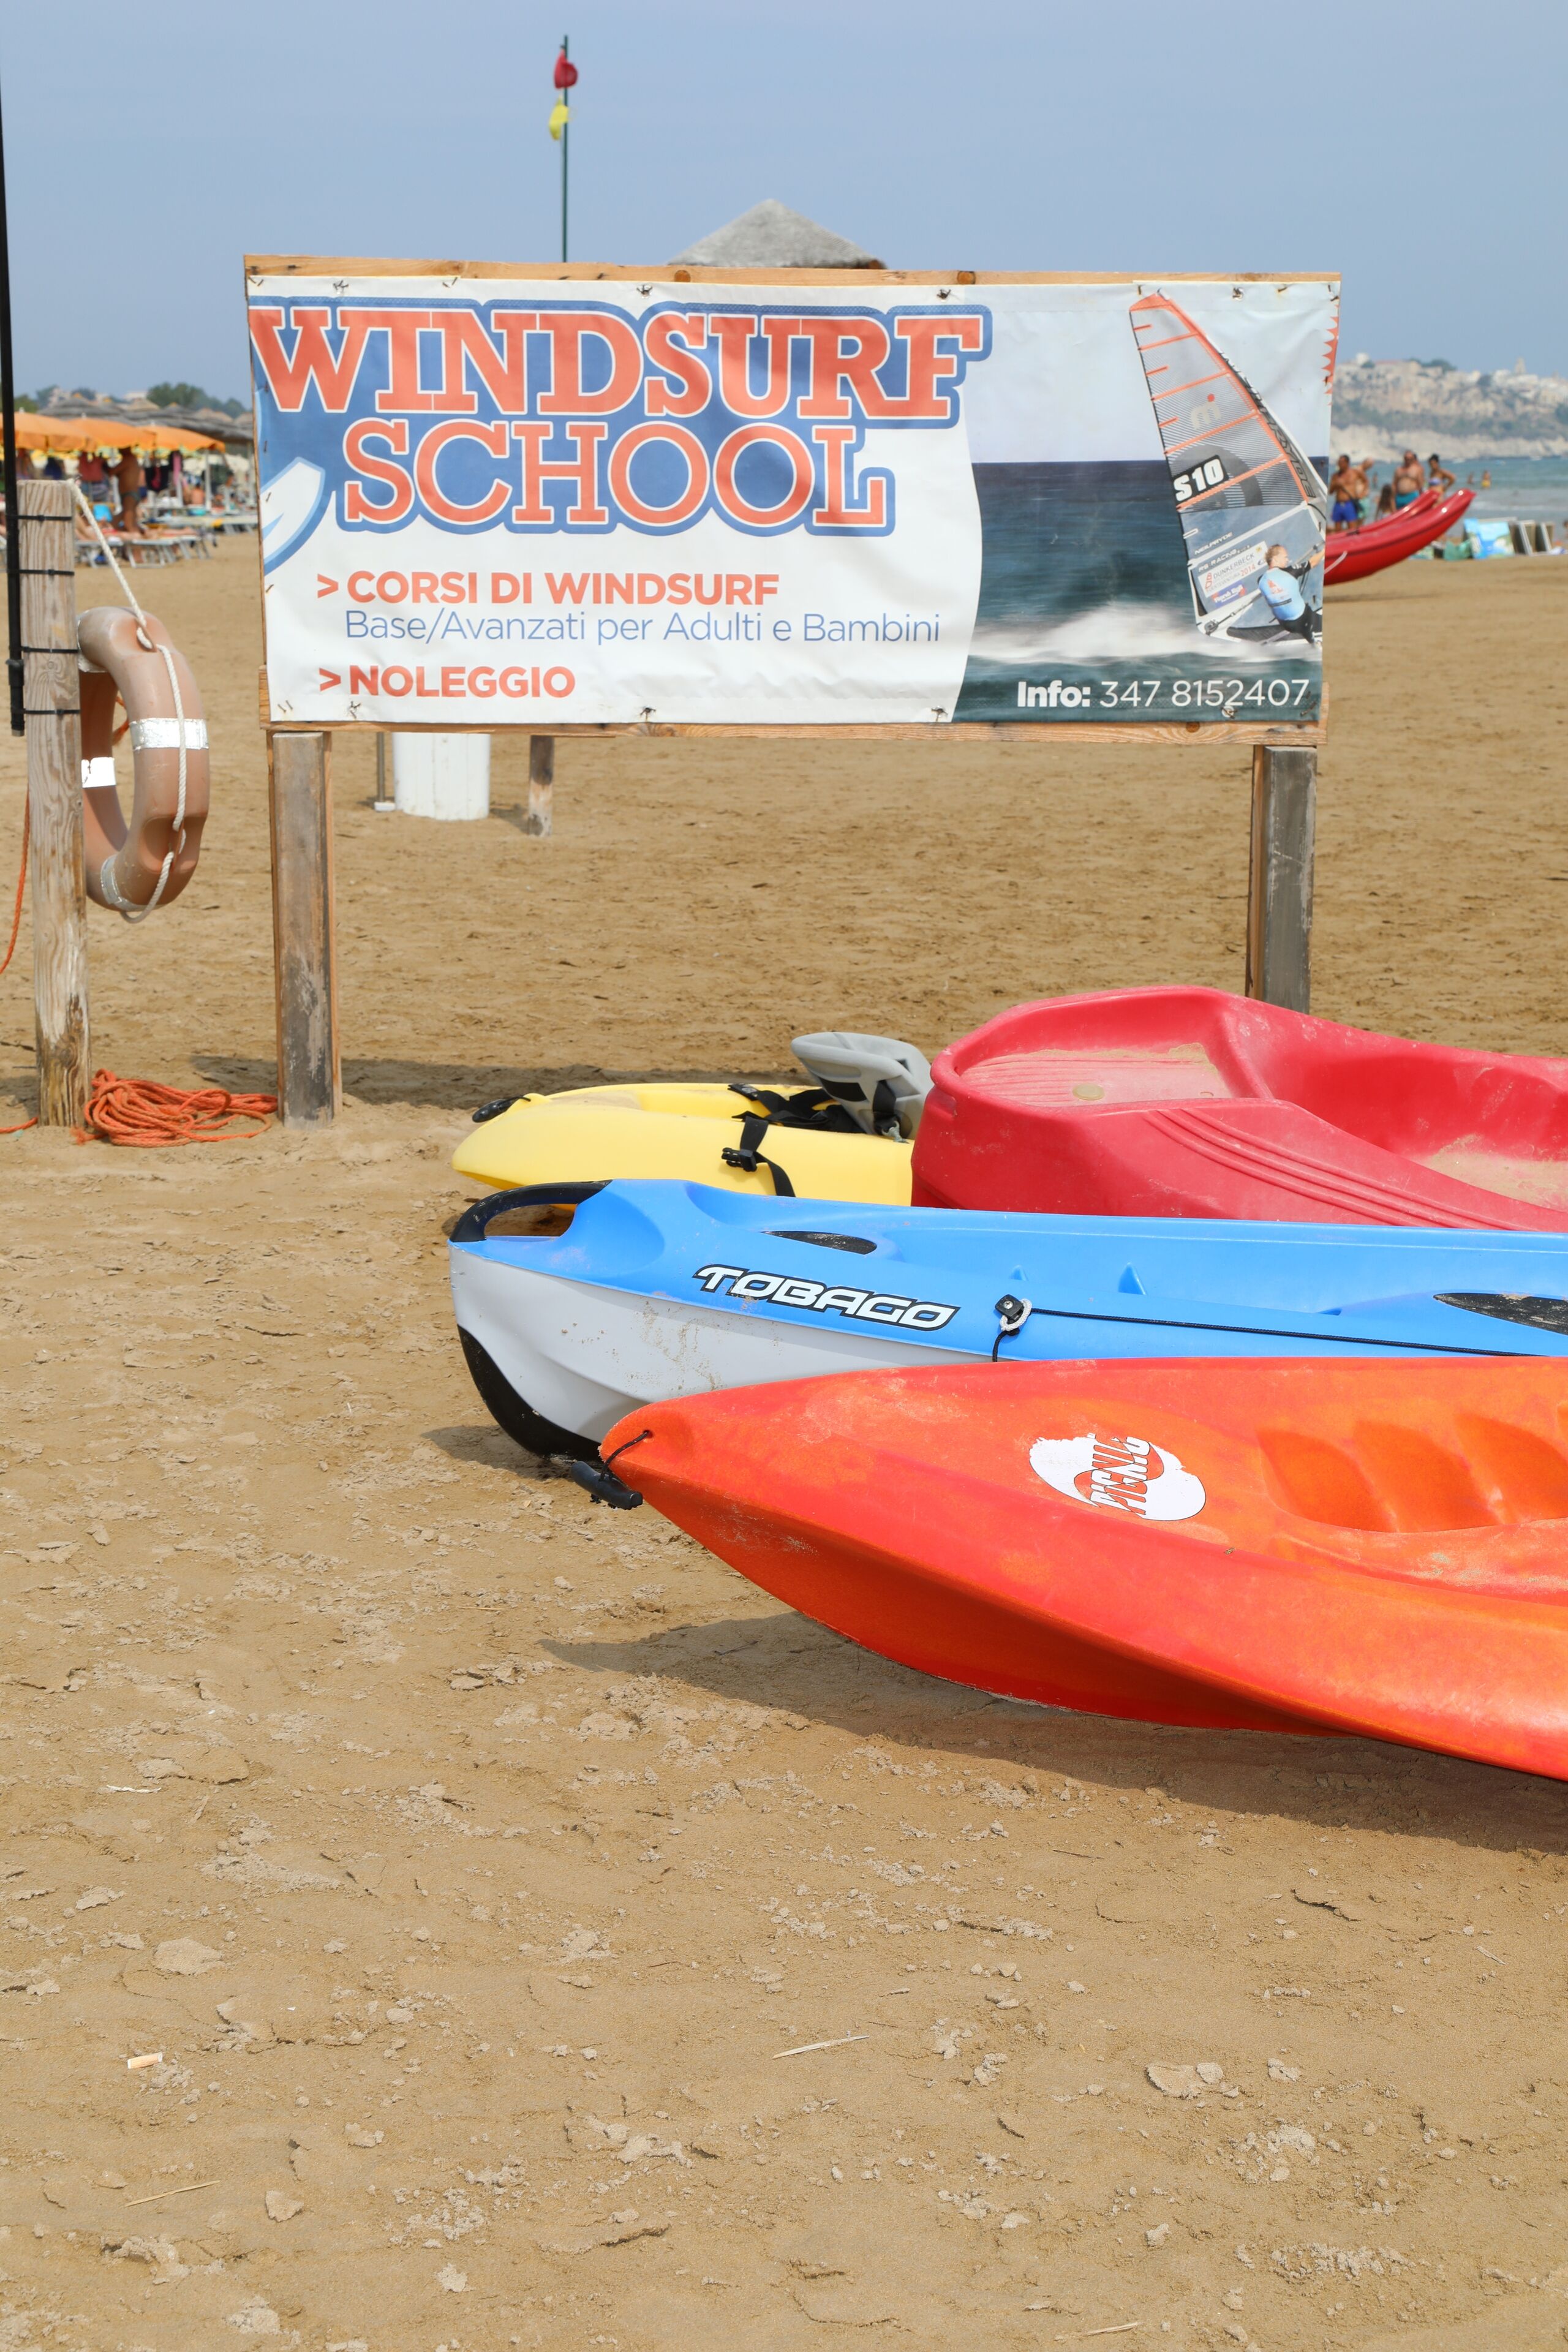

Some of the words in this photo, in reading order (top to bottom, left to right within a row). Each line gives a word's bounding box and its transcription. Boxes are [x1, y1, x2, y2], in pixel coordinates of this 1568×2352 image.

[248, 307, 982, 418] WINDSURF
[343, 418, 886, 527] SCHOOL
[1173, 458, 1224, 502] S10
[1213, 552, 1254, 579] DUNKERBECK
[1241, 564, 1256, 576] 2014
[347, 570, 478, 604] CORSI
[491, 572, 532, 605] DI
[545, 573, 780, 605] WINDSURF
[345, 608, 586, 644] Base/Avanzati
[597, 617, 654, 646] per
[663, 612, 762, 641] Adulti
[772, 619, 792, 642] e
[803, 613, 940, 642] Bambini
[349, 665, 576, 698] NOLEGGIO
[1017, 680, 1091, 707] Info:
[1099, 680, 1161, 707] 347
[1171, 679, 1310, 707] 8152407
[693, 1264, 960, 1331] TOBAGO
[1090, 1436, 1151, 1515] PICNIC
